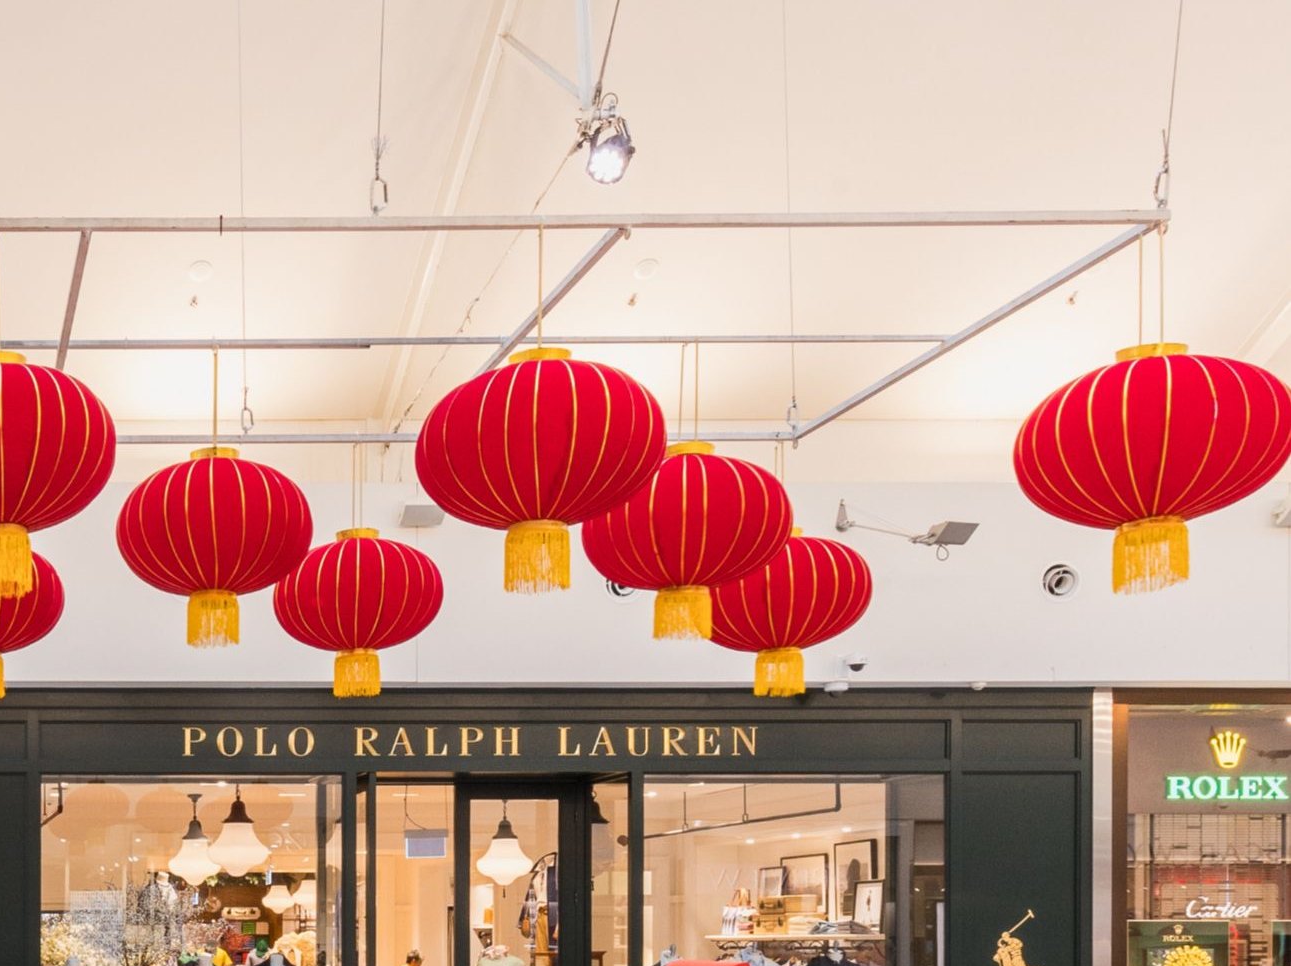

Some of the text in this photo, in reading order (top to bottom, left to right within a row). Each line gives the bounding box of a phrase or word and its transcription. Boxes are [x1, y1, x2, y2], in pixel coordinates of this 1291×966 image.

[182, 727, 759, 757] POLO RALPH LAUREN
[1168, 776, 1289, 800] ROLEX
[1186, 896, 1258, 918] Cartier
[1162, 934, 1194, 942] ROLEX
